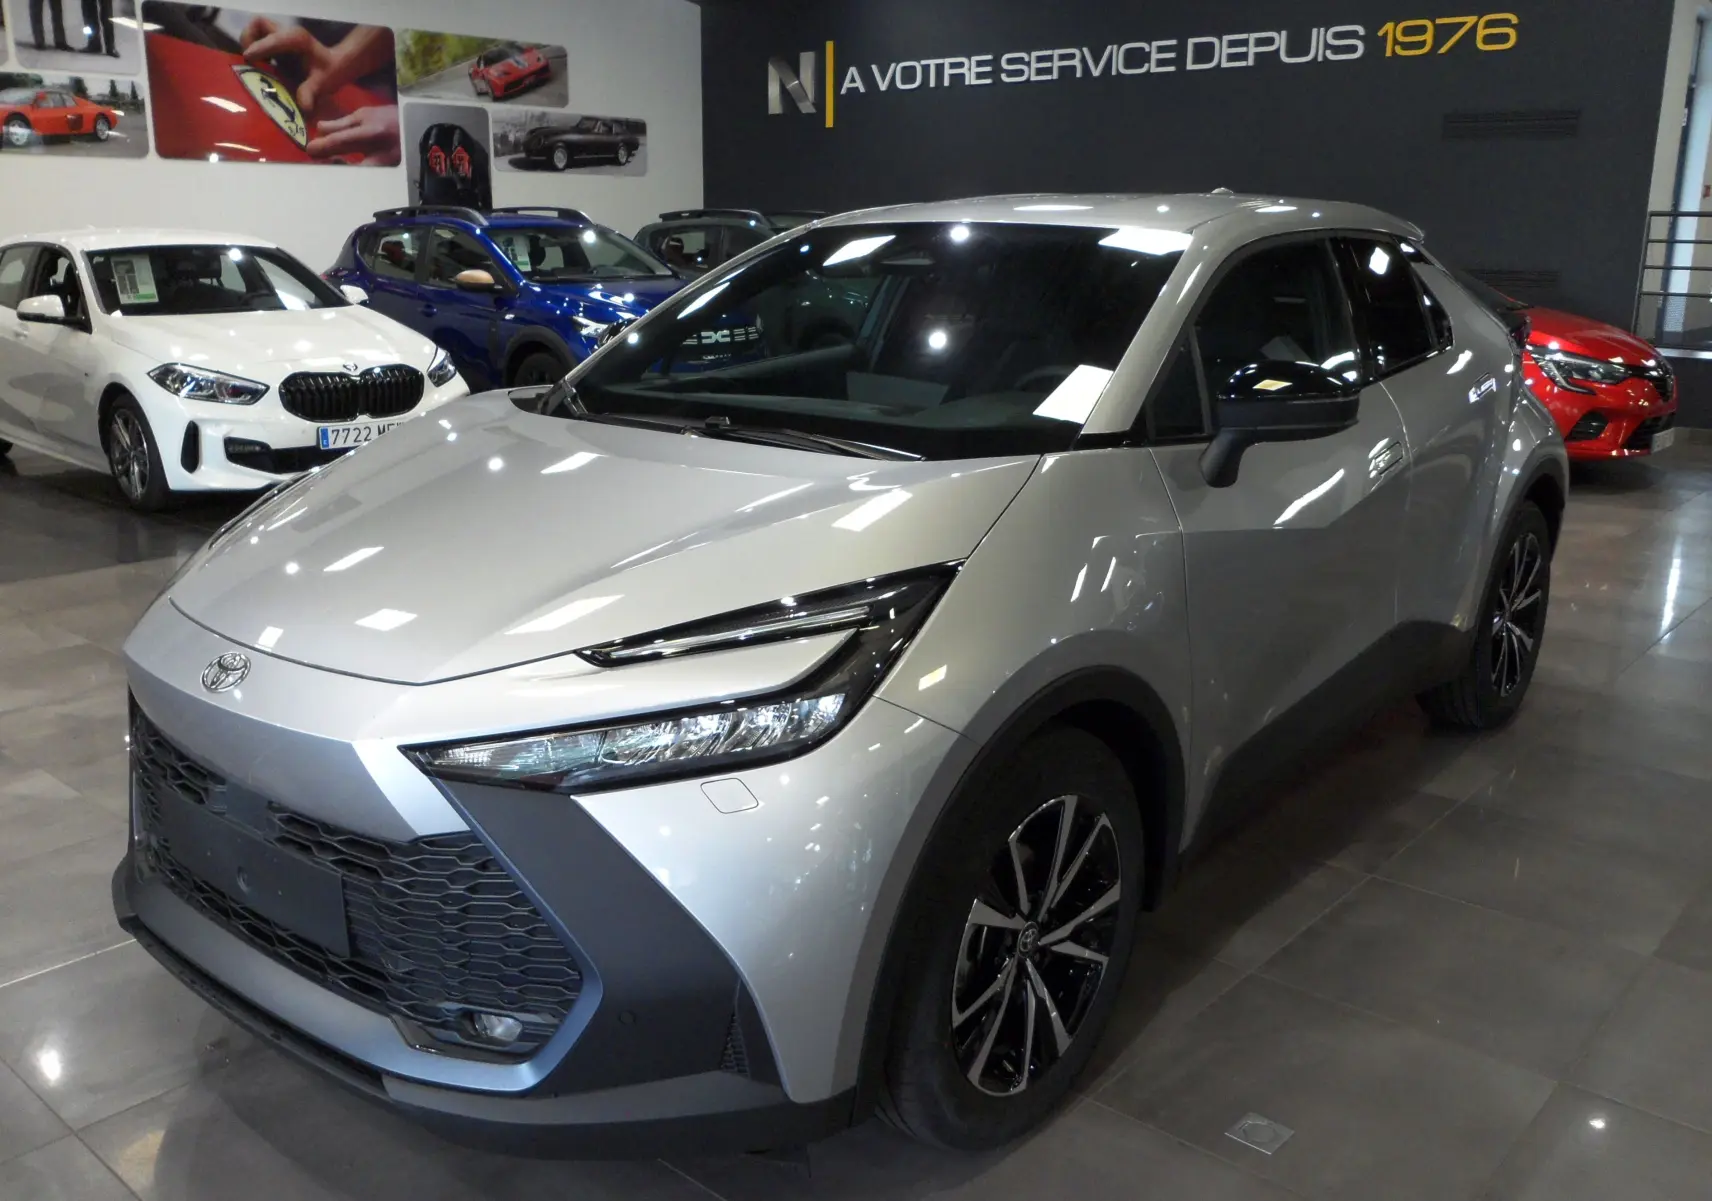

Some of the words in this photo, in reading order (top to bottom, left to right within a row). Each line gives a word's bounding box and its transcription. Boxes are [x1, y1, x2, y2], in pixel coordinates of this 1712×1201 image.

[840, 66, 866, 95] A
[870, 55, 994, 92] VOTRE
[1000, 39, 1178, 84] SERVICE
[1185, 24, 1366, 71] DEPUIS
[1376, 12, 1520, 58] 1976
[331, 426, 373, 445] 7722
